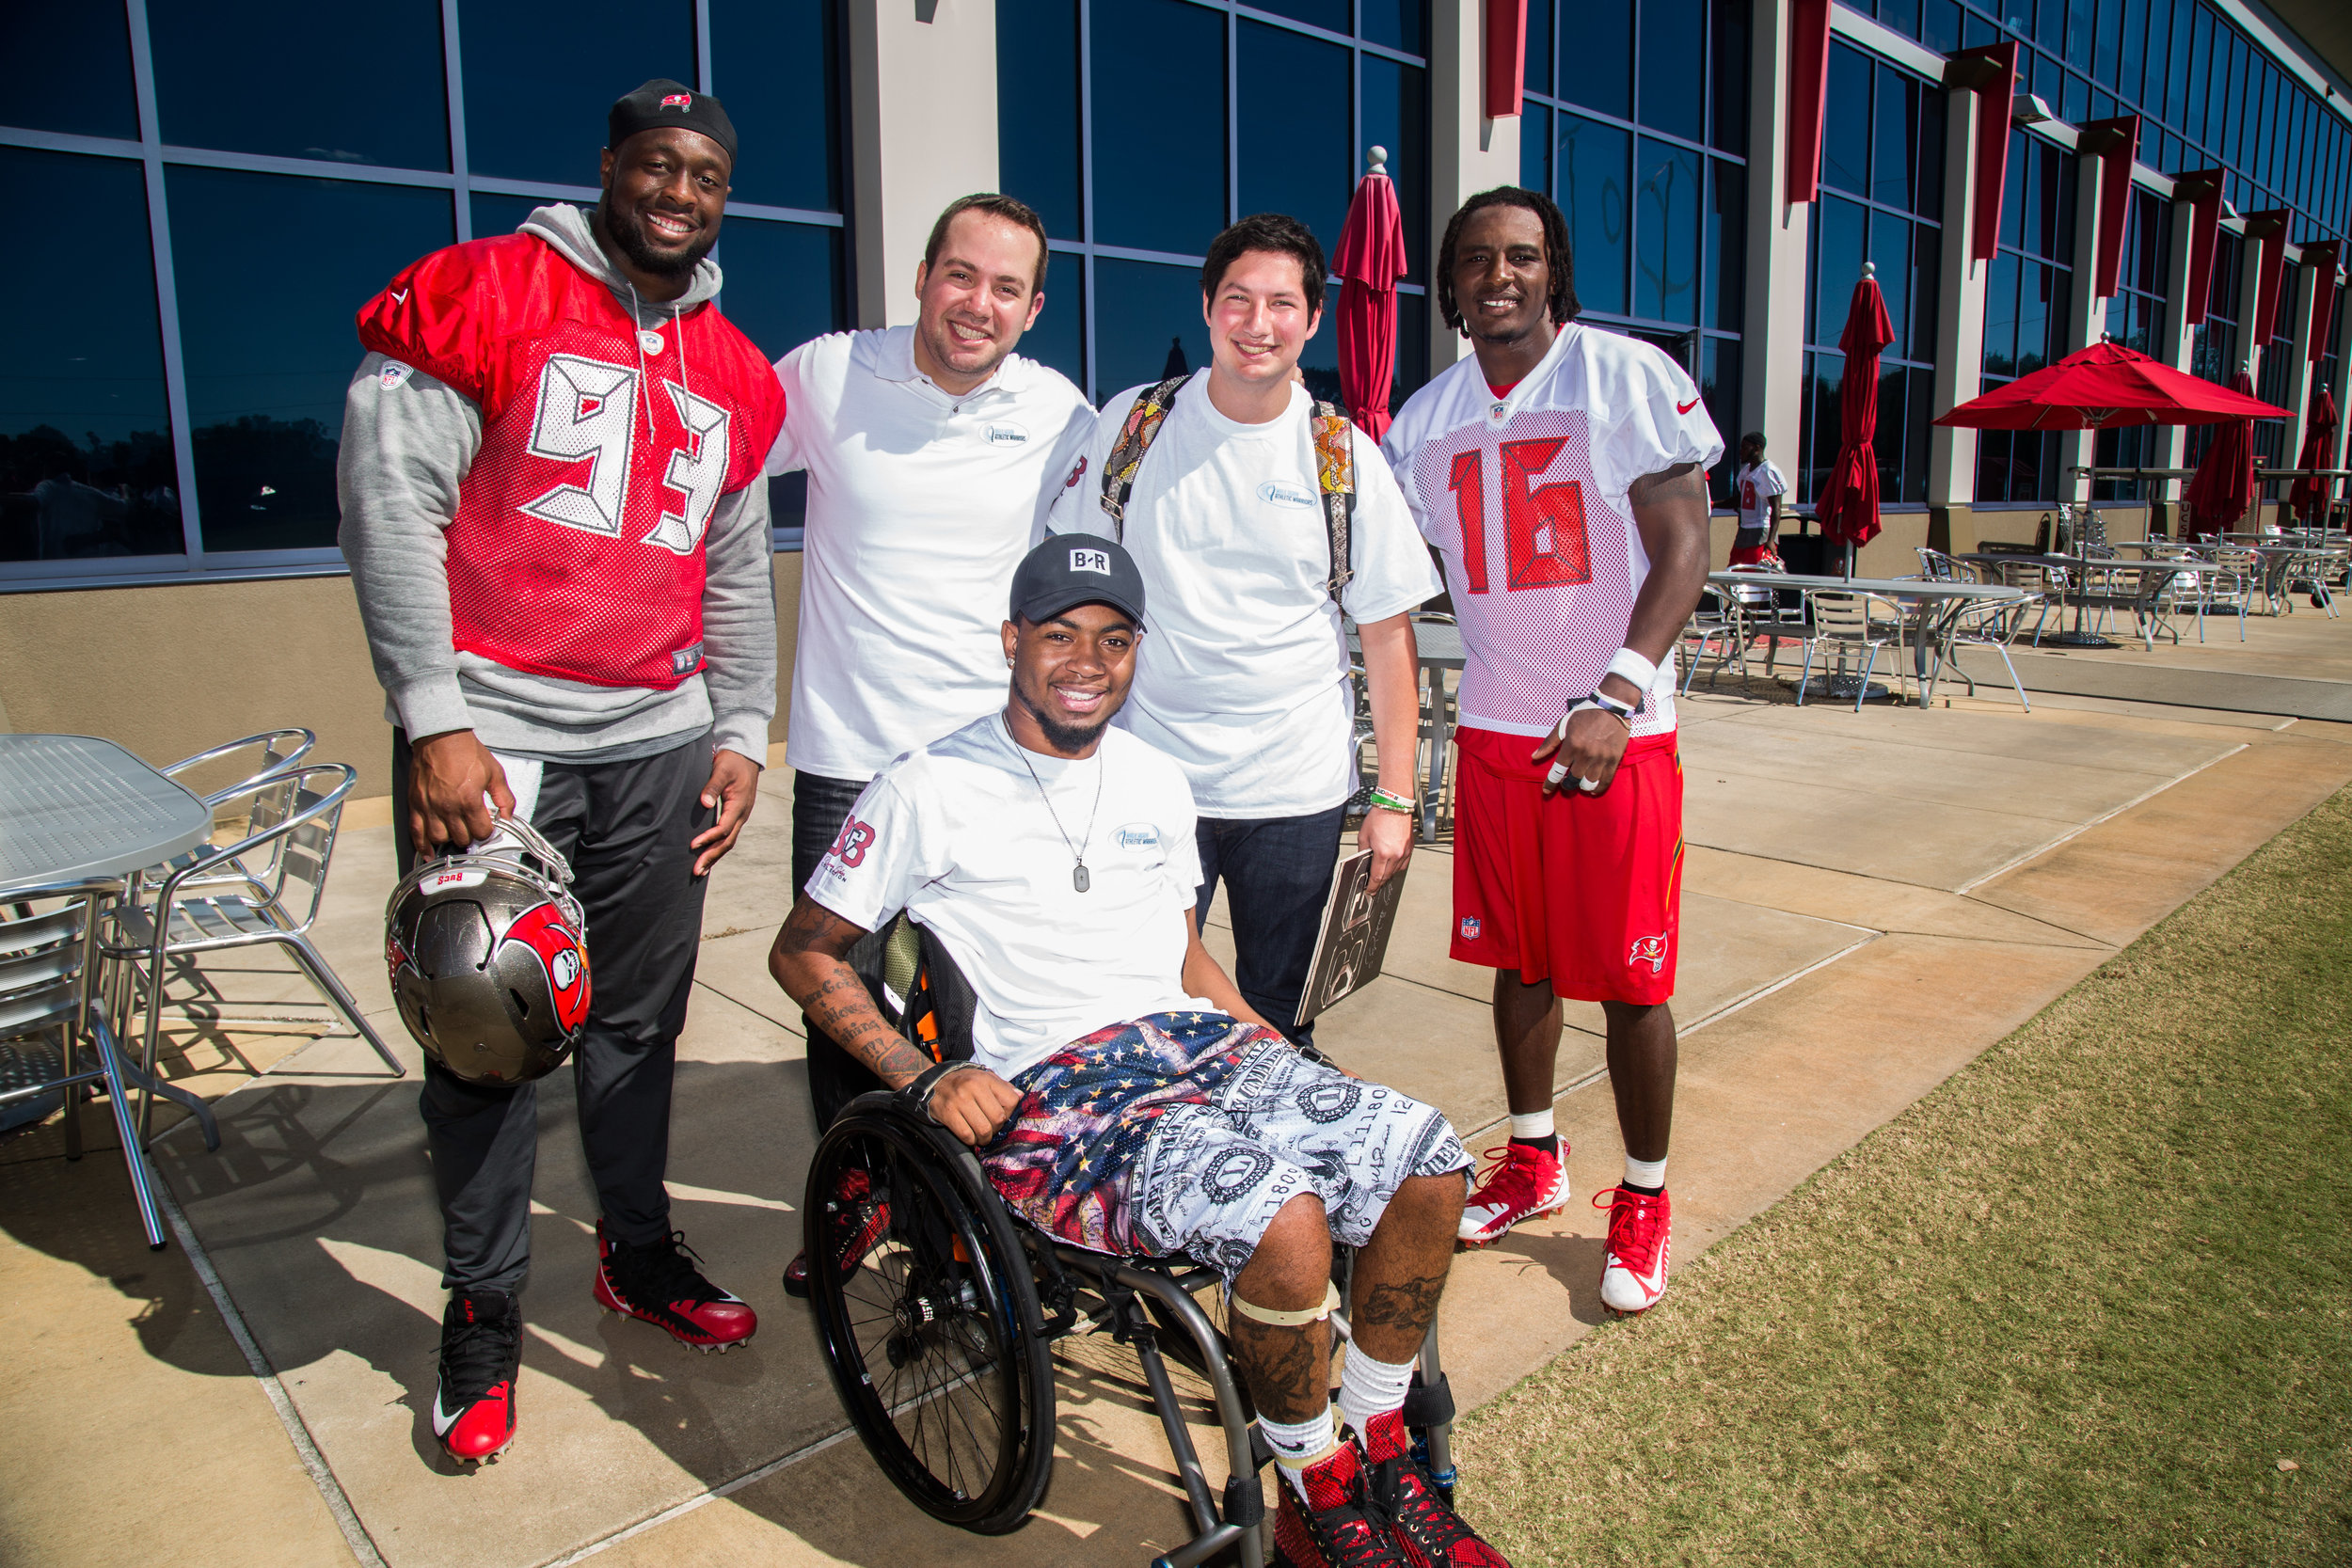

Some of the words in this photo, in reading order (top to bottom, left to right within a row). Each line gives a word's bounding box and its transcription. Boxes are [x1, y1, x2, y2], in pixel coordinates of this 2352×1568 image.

[517, 353, 731, 555] 93
[1449, 436, 1593, 594] 16
[1464, 926, 1478, 937] NFL
[1391, 1099, 1414, 1115] 12
